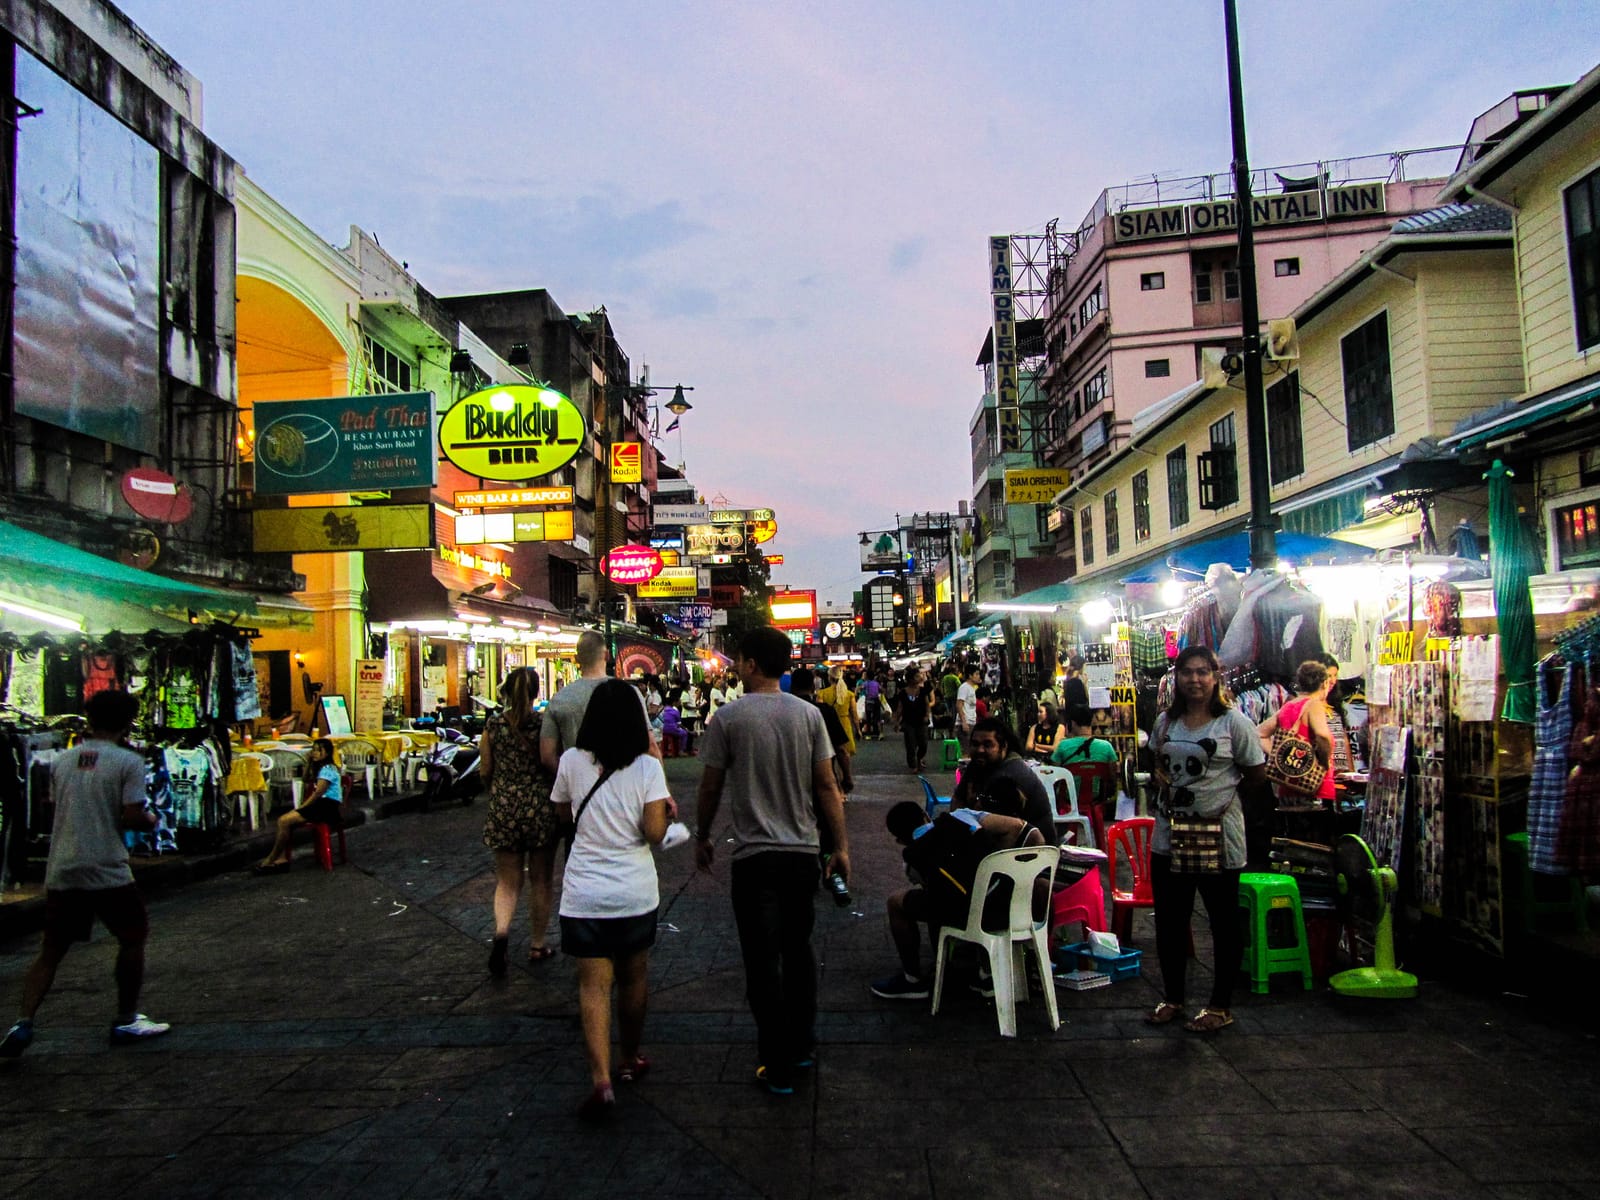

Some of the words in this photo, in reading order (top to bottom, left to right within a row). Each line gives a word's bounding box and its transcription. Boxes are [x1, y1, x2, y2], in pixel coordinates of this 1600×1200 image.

[1119, 210, 1181, 238] SIAM
[1194, 195, 1318, 228] ORINTAL
[1333, 186, 1379, 213] INN
[992, 238, 1011, 290] SIAM
[995, 295, 1015, 406] ORIENTAL
[340, 405, 378, 431] Pad
[384, 404, 427, 428] Thai
[465, 402, 559, 446] Buddy
[344, 429, 424, 442] RESTAURANT
[1001, 411, 1018, 450] INN
[353, 443, 373, 451] Khao
[395, 440, 416, 448] Road
[488, 447, 539, 465] BEER
[613, 467, 638, 475] Kodak
[1009, 476, 1029, 487] SIAM
[1029, 475, 1065, 486] ORIENTAL
[457, 495, 485, 504] WINE
[486, 493, 508, 503] BAR
[510, 493, 519, 502] &
[521, 490, 571, 502] SEAFOOD
[680, 606, 692, 619] SIM
[693, 605, 712, 618] CARD
[359, 670, 383, 680] true
